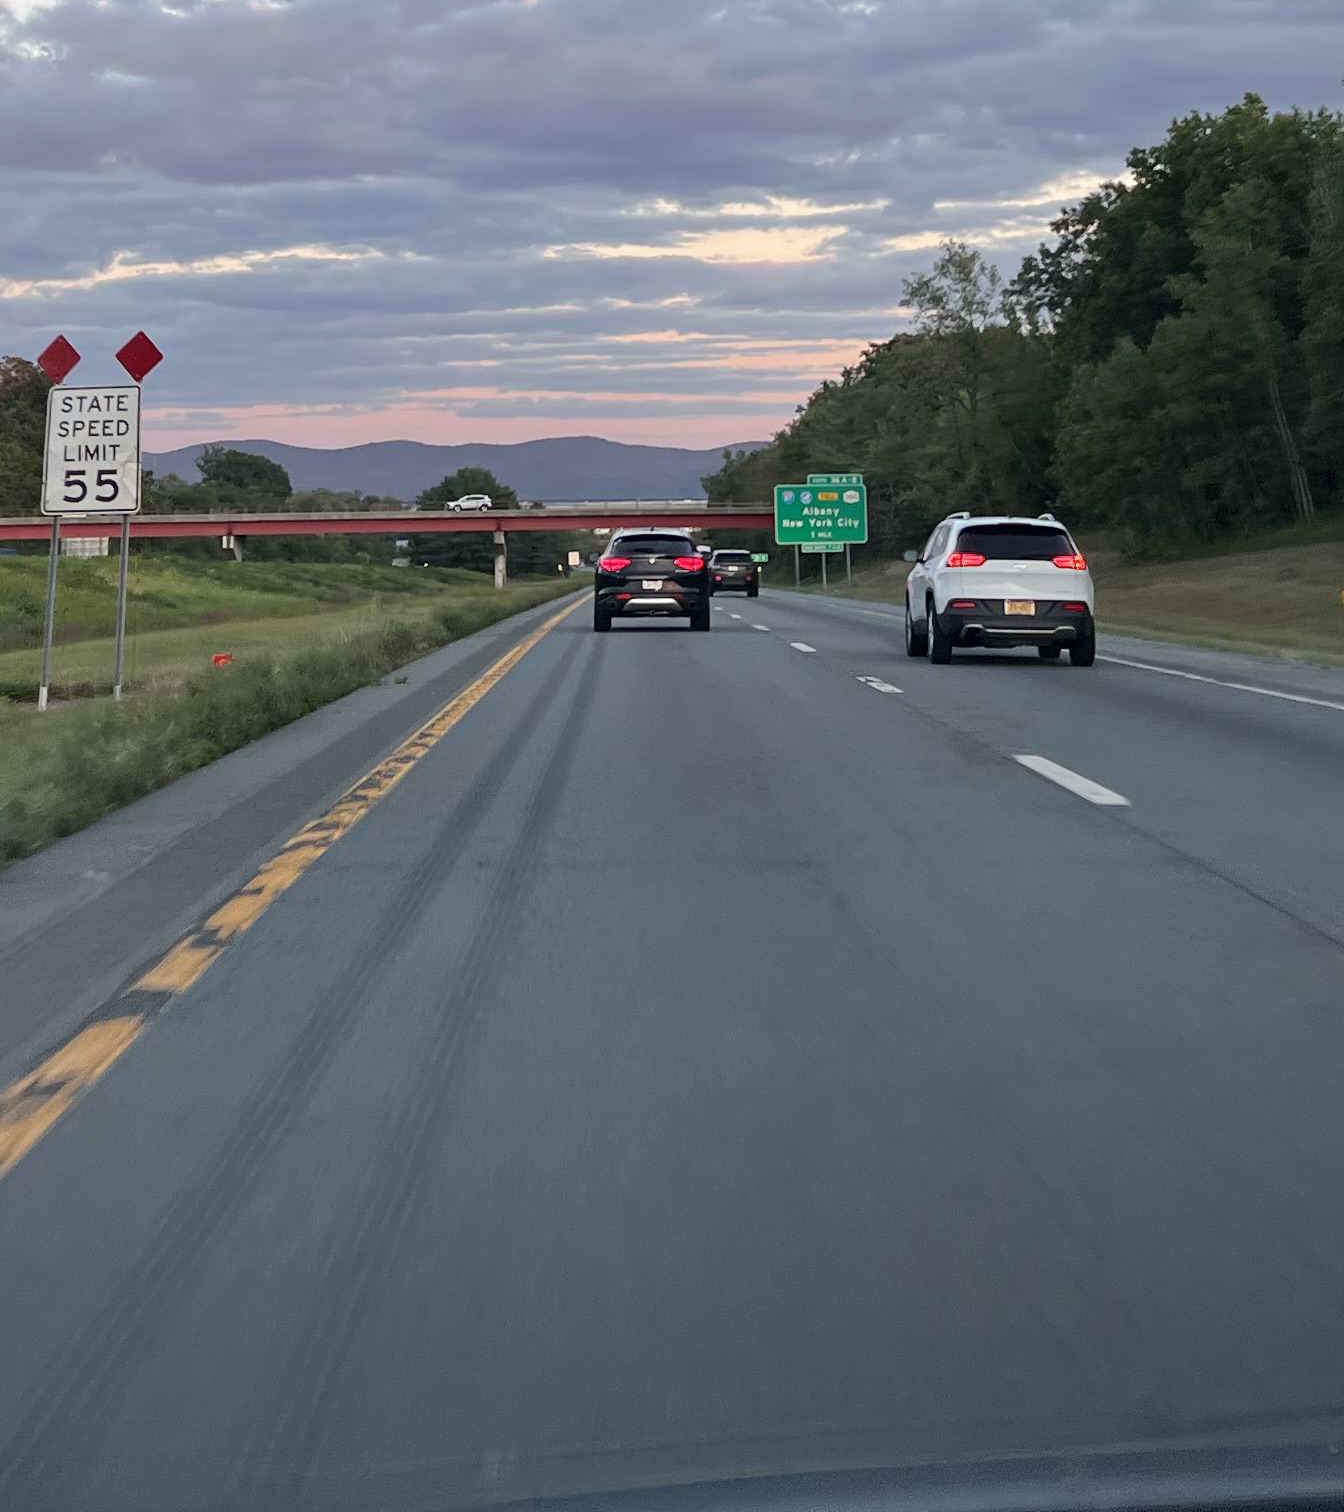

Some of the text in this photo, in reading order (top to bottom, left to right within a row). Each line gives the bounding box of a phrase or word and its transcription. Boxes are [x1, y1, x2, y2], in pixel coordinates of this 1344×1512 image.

[61, 395, 129, 413] STATE
[57, 420, 129, 438] SPEED
[63, 444, 120, 462] LIMIT
[62, 469, 119, 503] 55
[802, 507, 840, 517] Albany
[782, 518, 860, 529] New York City
